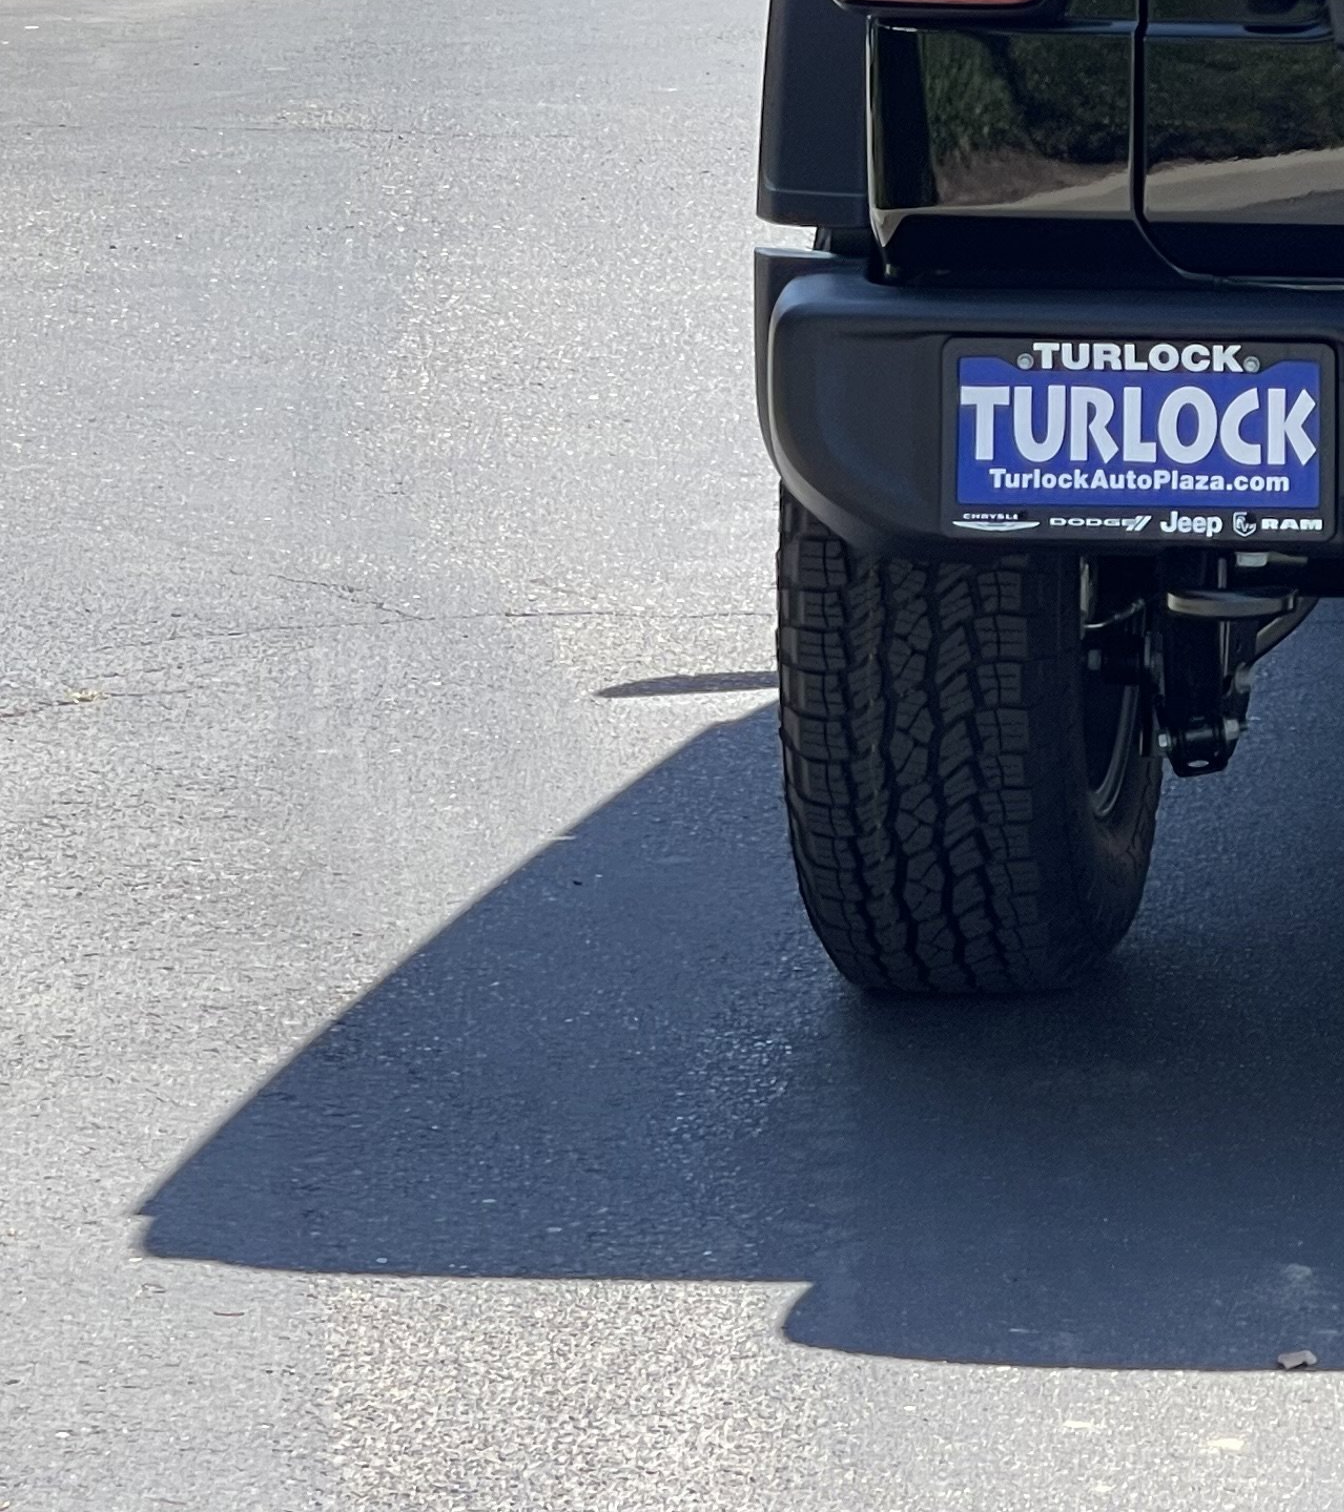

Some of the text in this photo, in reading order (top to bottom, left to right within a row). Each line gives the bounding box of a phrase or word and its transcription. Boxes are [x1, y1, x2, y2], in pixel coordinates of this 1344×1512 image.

[1032, 342, 1245, 373] TURLOCK
[960, 385, 1318, 466] TURLOCK
[989, 468, 1290, 492] TurlockAutoPlaza.com
[1159, 510, 1224, 538] Jeep
[1261, 517, 1323, 530] RAM
